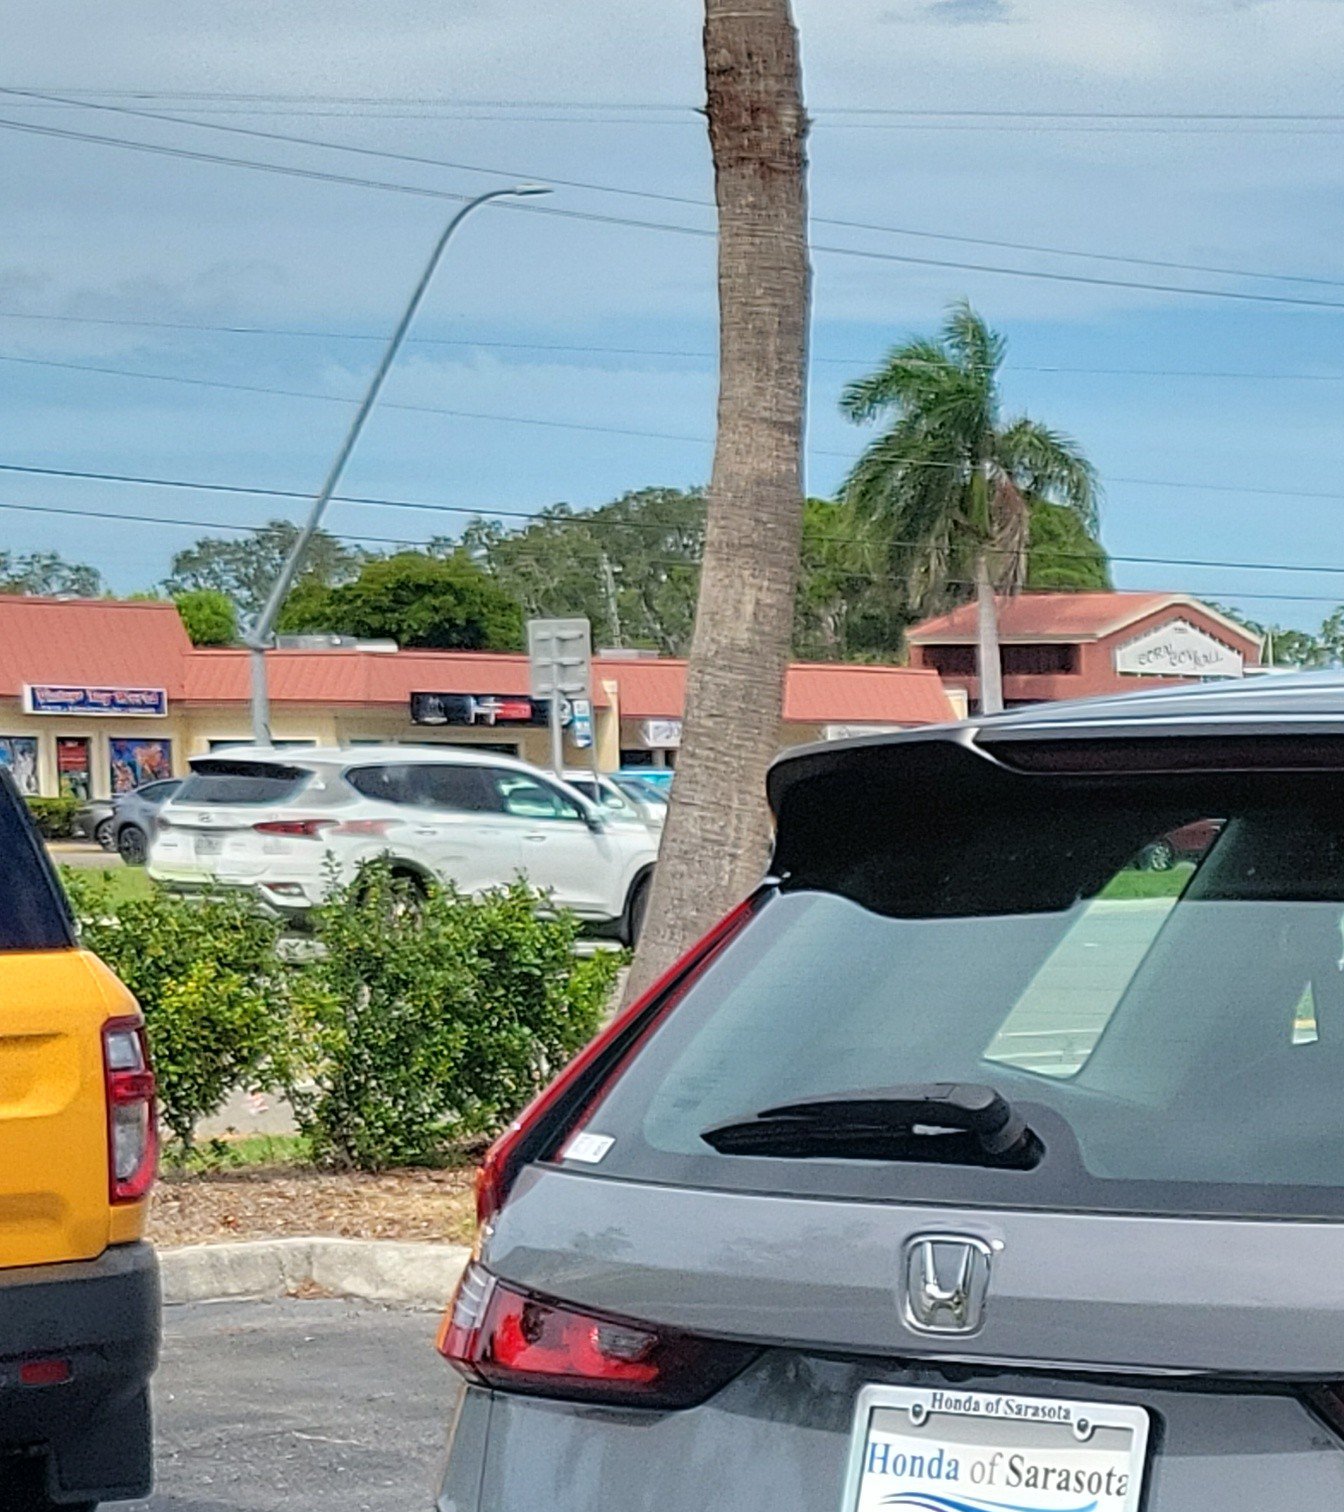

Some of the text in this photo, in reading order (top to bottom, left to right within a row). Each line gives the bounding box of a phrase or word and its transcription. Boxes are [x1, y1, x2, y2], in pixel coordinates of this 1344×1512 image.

[931, 1392, 1072, 1421] Honda of Sarasota
[867, 1442, 1130, 1497] Honda of Sarasota
